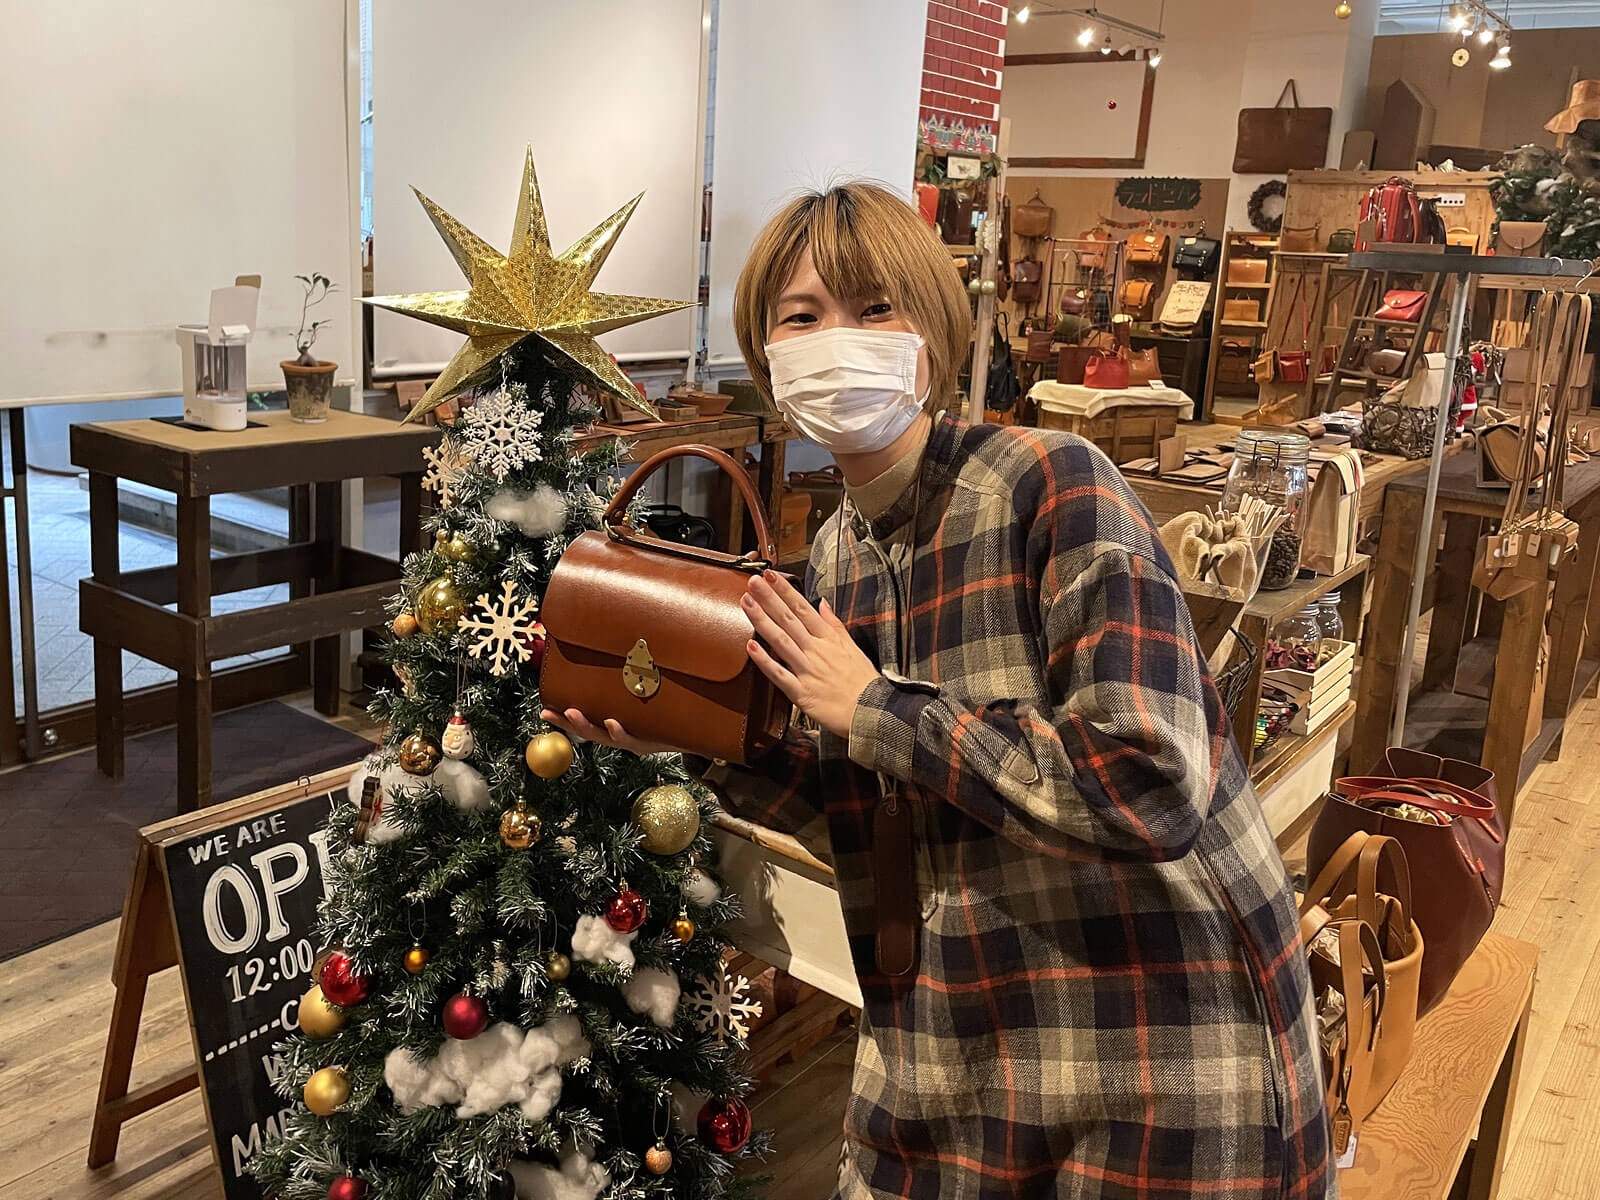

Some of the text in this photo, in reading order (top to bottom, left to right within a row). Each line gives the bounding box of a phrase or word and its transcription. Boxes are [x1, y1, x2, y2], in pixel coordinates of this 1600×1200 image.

[187, 812, 287, 866] WE ARE
[203, 829, 334, 955] OP
[225, 938, 314, 1004] 12:00
